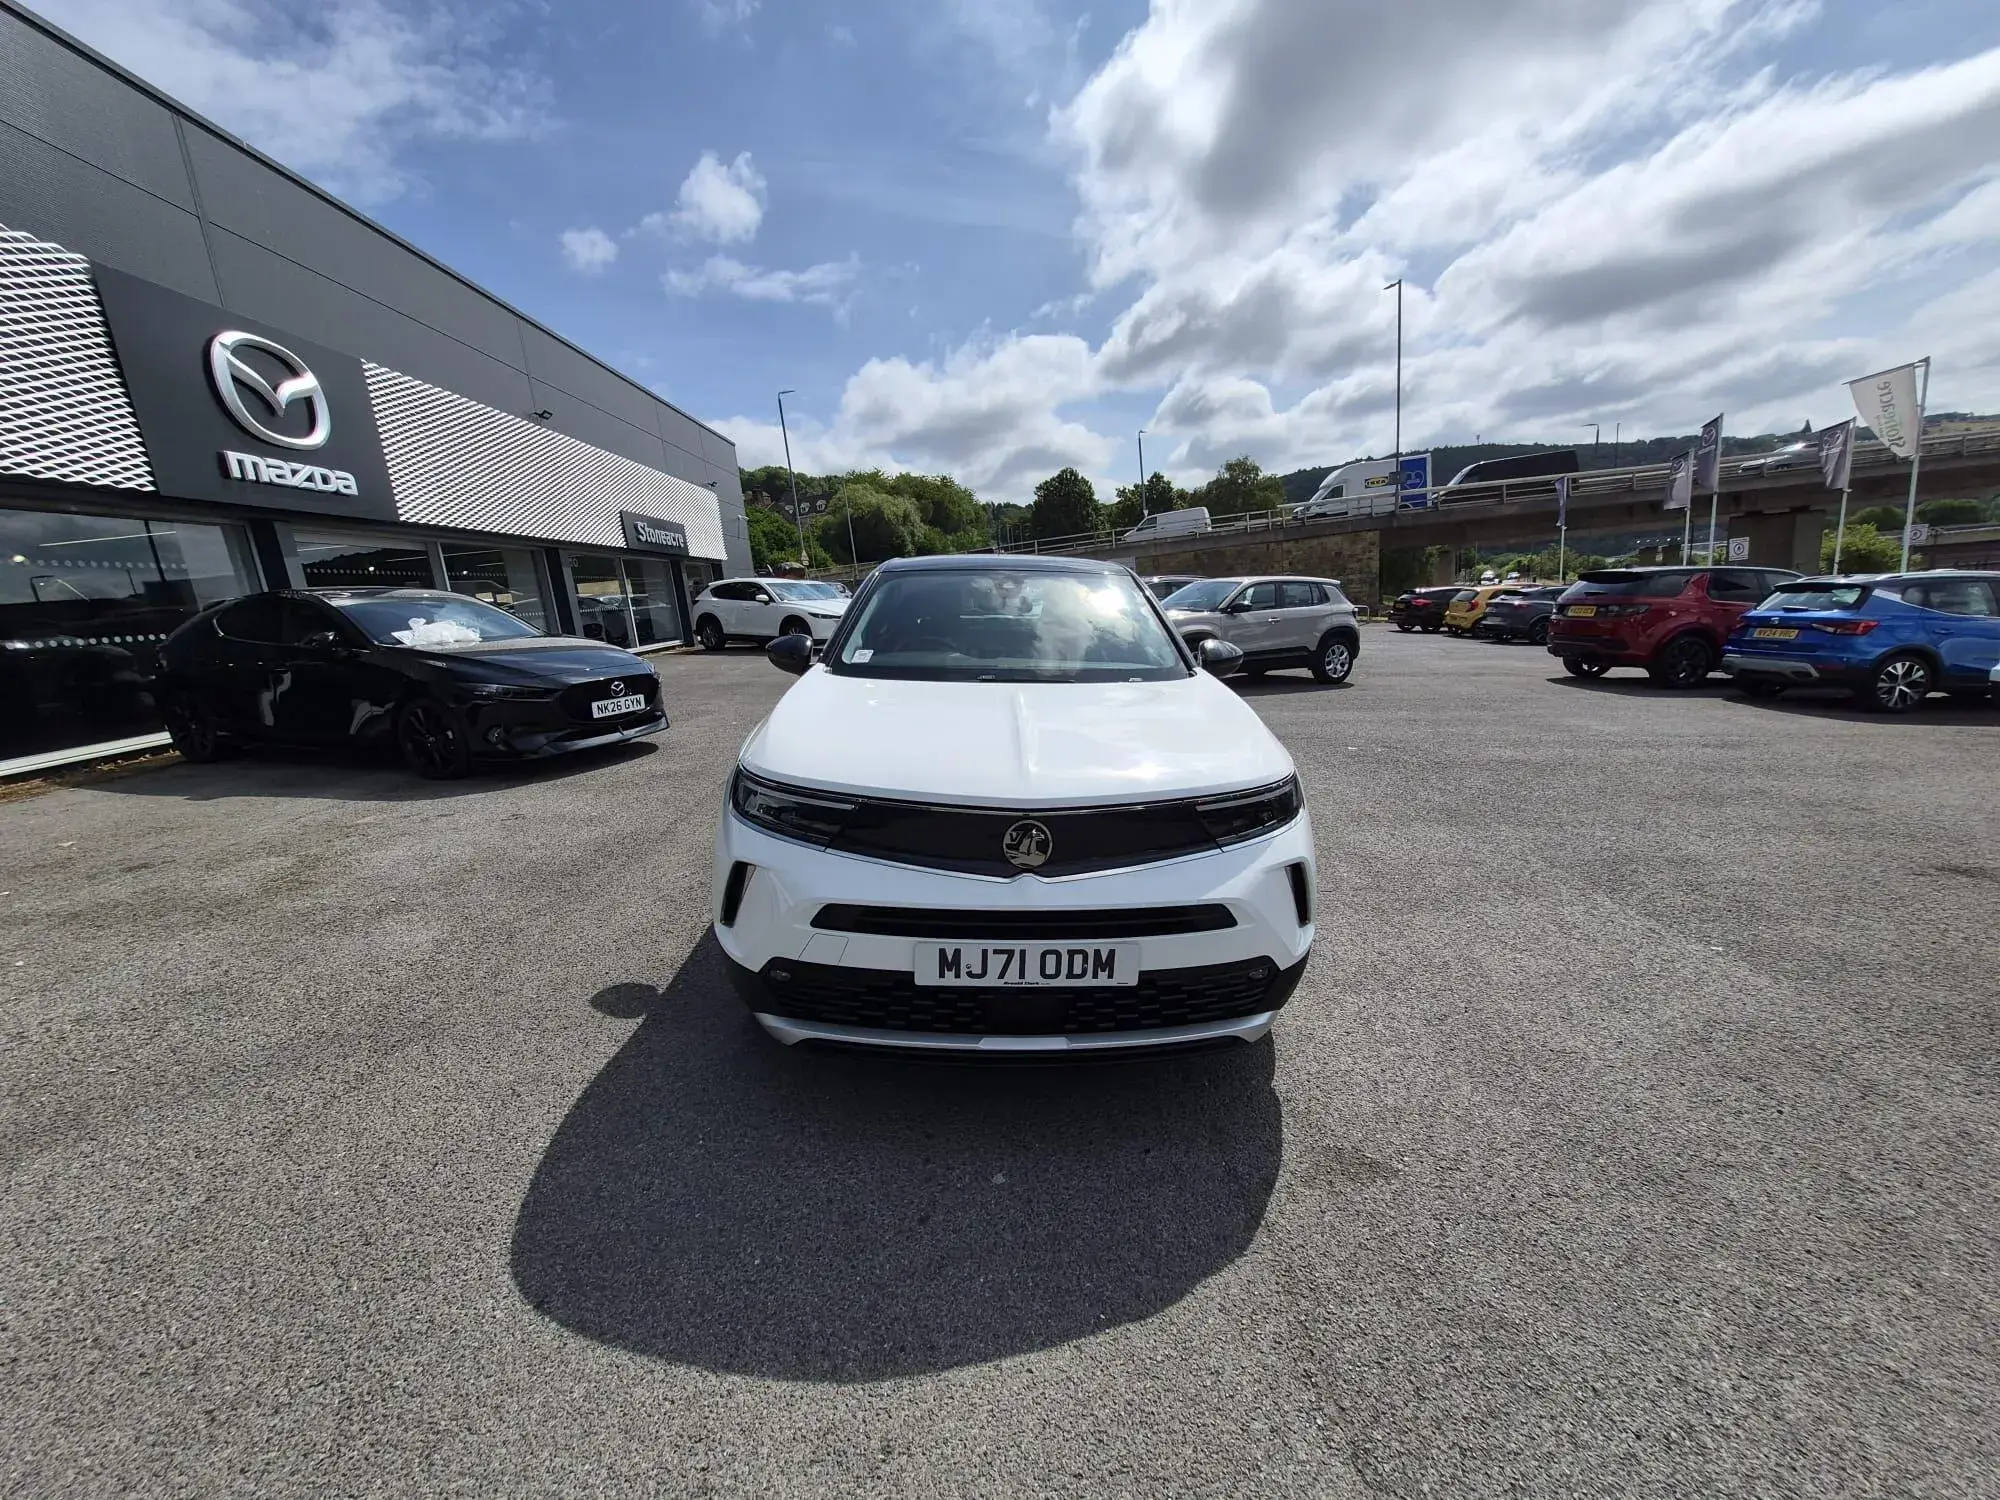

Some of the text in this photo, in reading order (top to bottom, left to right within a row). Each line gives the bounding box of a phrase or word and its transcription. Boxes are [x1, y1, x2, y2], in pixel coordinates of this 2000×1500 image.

[634, 521, 684, 548] Stoneacre
[597, 697, 642, 715] NK26 GYN
[938, 947, 1116, 980] MJ71 ODM
